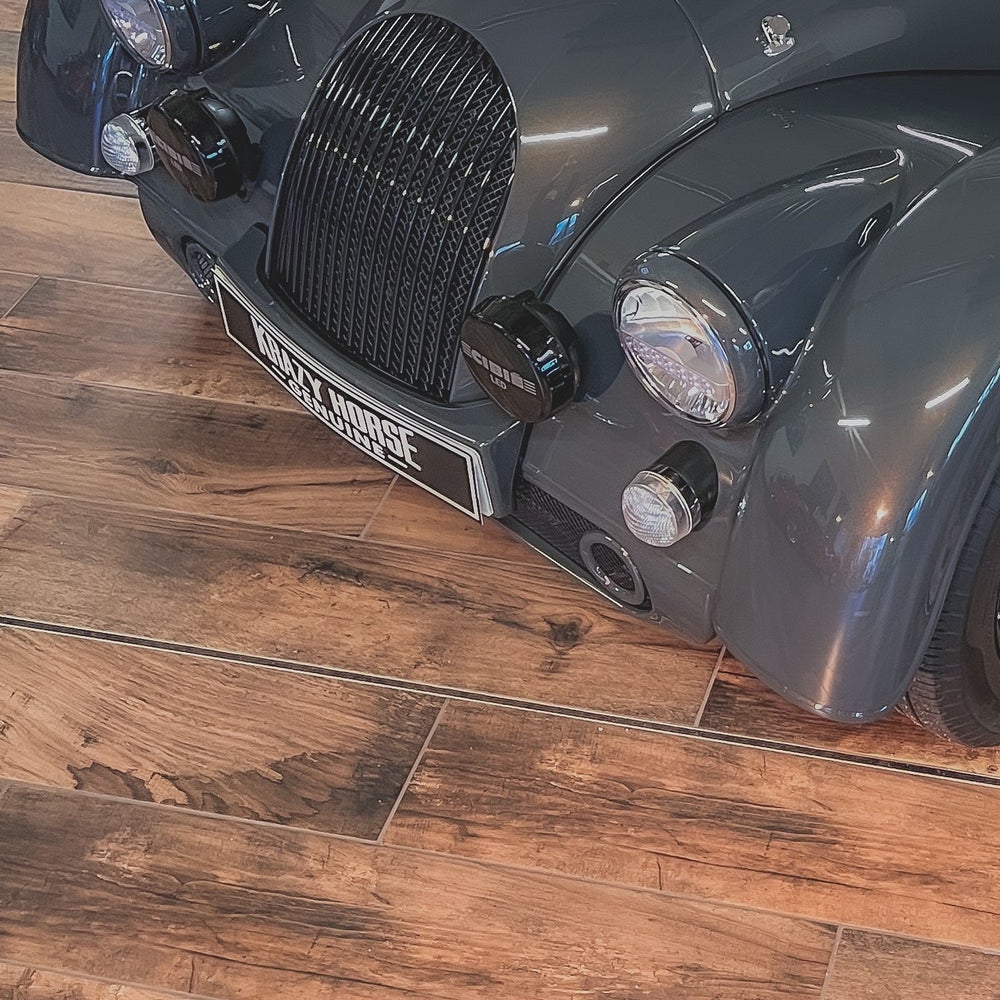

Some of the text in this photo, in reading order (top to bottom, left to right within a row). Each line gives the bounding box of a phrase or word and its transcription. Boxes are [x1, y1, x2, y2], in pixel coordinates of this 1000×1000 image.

[250, 315, 422, 472] KRAZY HORSE
[288, 379, 386, 459] GENUINE
[489, 374, 508, 390] LED
